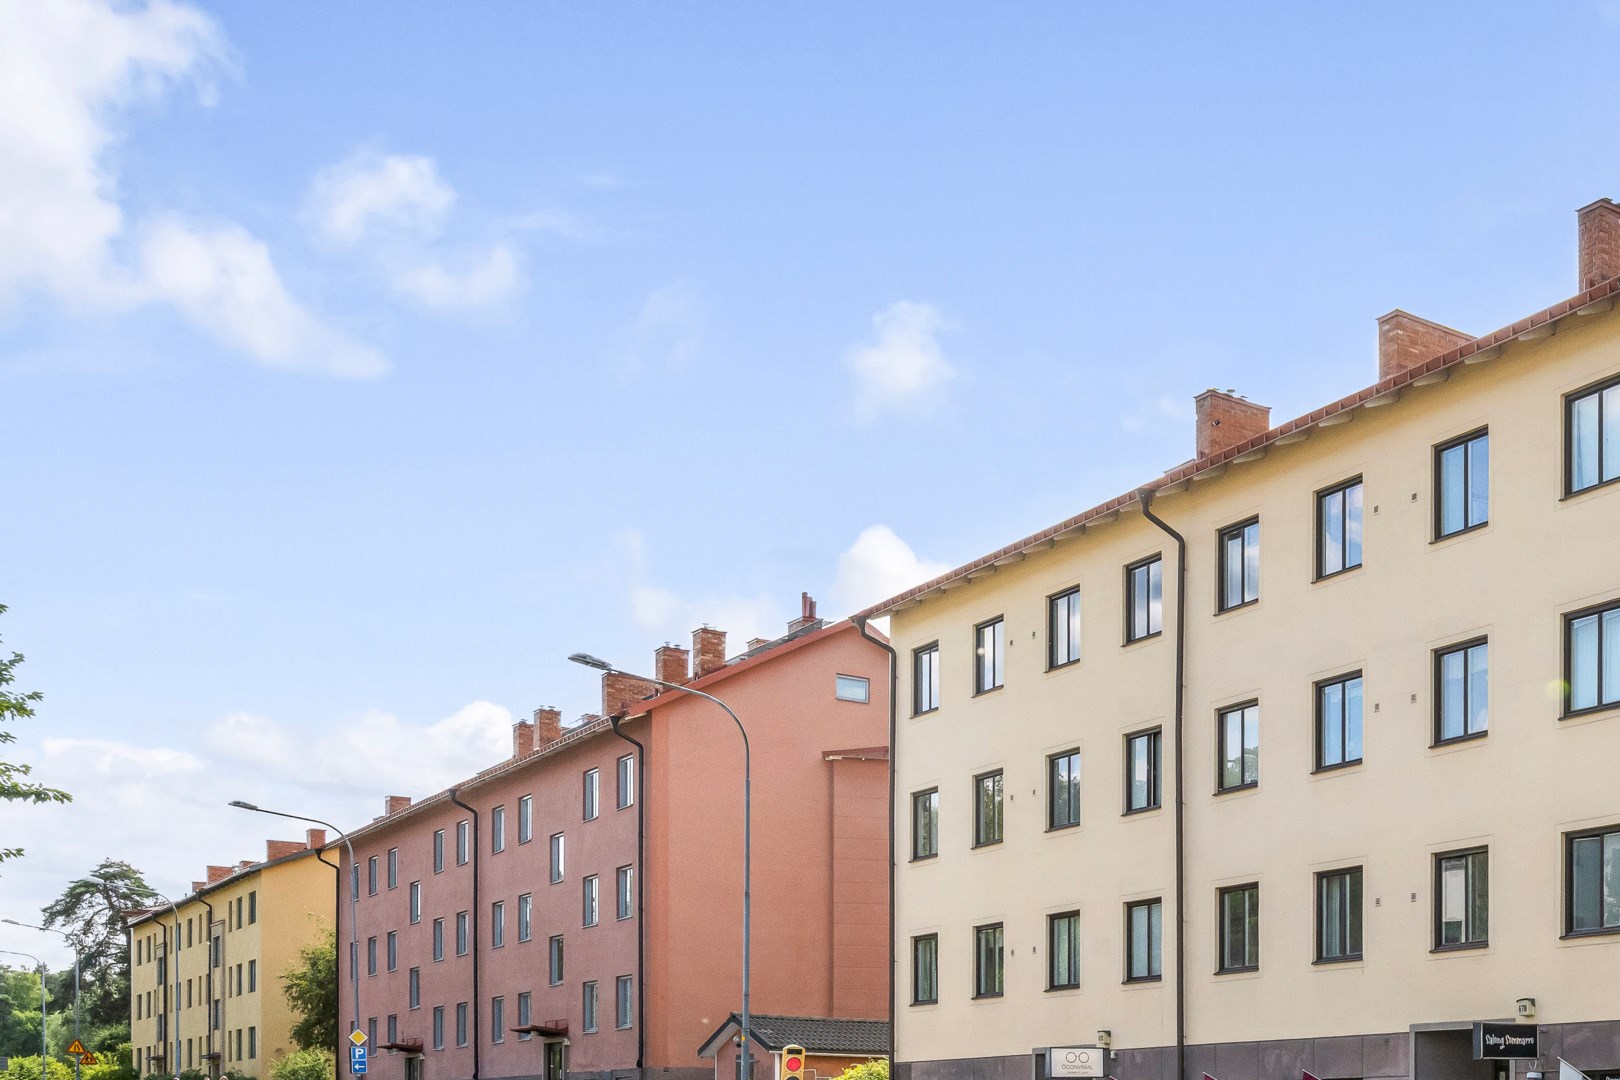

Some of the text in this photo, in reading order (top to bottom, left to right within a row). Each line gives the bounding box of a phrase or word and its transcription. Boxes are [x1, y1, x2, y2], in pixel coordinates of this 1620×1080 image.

[1485, 1033, 1535, 1050] Salong Sommarro
[355, 1048, 364, 1059] P
